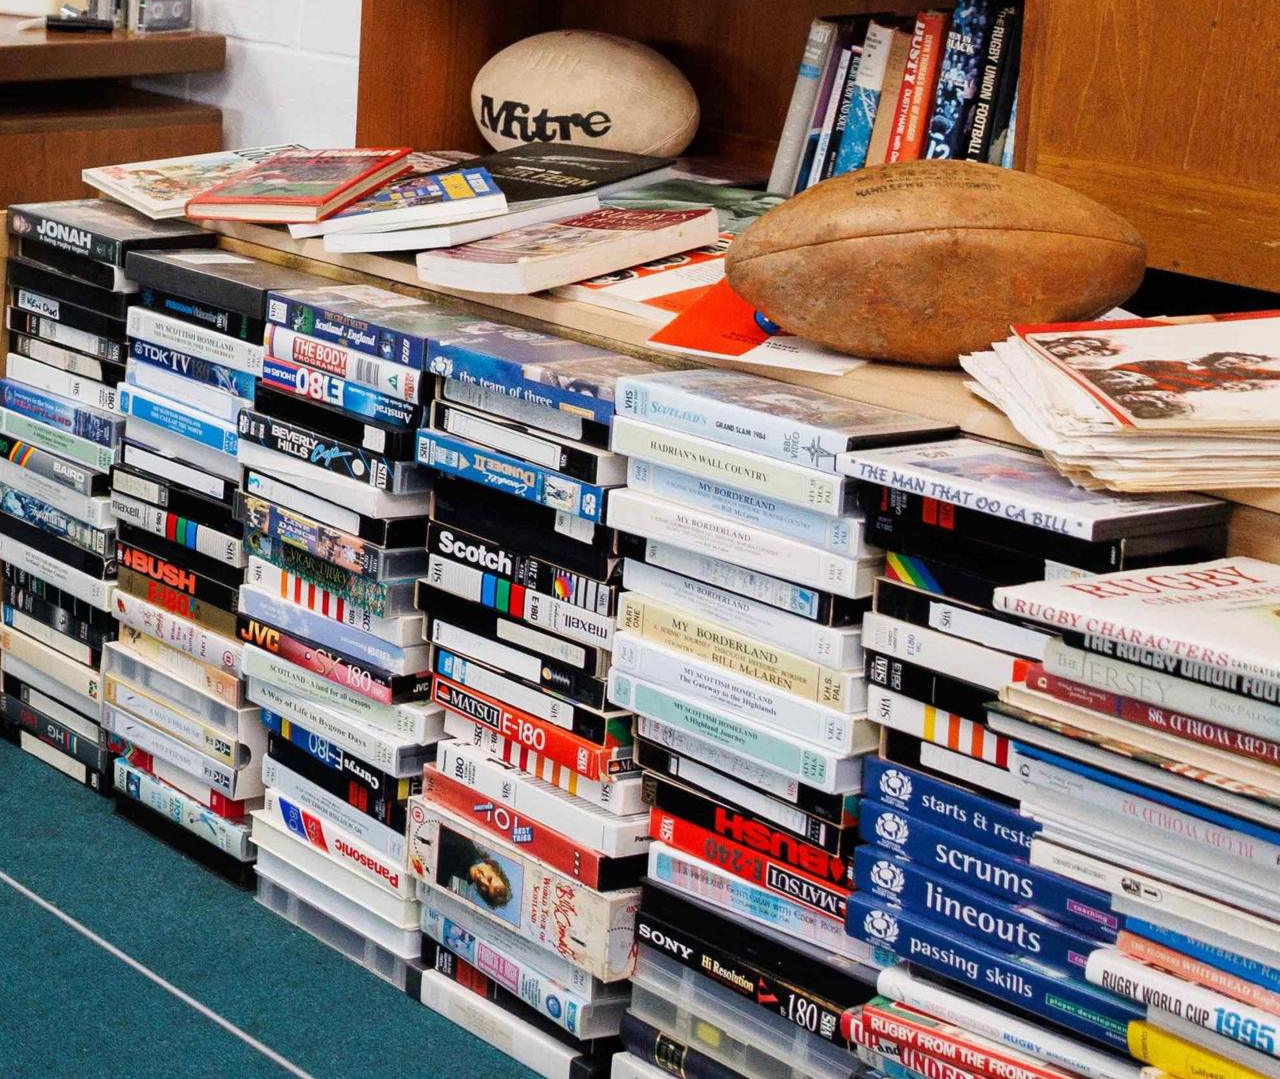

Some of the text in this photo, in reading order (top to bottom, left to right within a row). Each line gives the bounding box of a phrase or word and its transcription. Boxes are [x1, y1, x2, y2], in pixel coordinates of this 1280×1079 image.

[905, 21, 925, 83] DUSTY
[946, 40, 974, 54] BLACK
[967, 11, 1008, 153] THE RUGBY UNION FOOTBALL
[481, 94, 612, 142] Mitre
[836, 77, 859, 132] BODY AND SOUL
[926, 140, 951, 159] 12
[37, 220, 92, 249] JONAH
[294, 338, 348, 367] THE BODY
[294, 354, 347, 377] PROGRAMME
[295, 367, 345, 407] E180
[459, 372, 553, 408] the team of three
[625, 390, 633, 409] VHS
[373, 403, 413, 425] Amstrad
[272, 424, 318, 450] BEVERLY
[716, 421, 766, 440] GRAND SLAM 1984
[783, 433, 791, 454] BBC
[791, 431, 801, 459] VIDEO
[277, 439, 353, 467] HILLS Cop
[650, 440, 769, 483] HADRIAN'S WALL COUNTRY
[53, 462, 85, 482] BAIRD
[112, 500, 140, 519] maxell
[699, 482, 775, 512] MY BORDERLAND
[859, 462, 1069, 534] THE MAN THAT OO CA BILL
[677, 514, 751, 542] MY BORDERLAND
[438, 530, 512, 575] Scotch
[132, 550, 196, 594] BUSH
[1062, 566, 1268, 599] RUGBY
[148, 581, 190, 616] E-180
[531, 596, 539, 620] E-180
[684, 581, 751, 612] MY BORDERLAND
[563, 615, 608, 639] maxell
[625, 605, 633, 628] PART
[633, 609, 641, 629] ONE
[240, 621, 280, 652] JVC
[672, 618, 779, 665] MY BORDERLAND
[1014, 599, 1228, 667] RUGBY CHARACTERS
[315, 648, 373, 692] SX 180
[711, 653, 792, 690] BILL McLAREN
[875, 656, 888, 685] VHS
[413, 682, 429, 692] JVC
[832, 683, 841, 701] PAL
[451, 689, 499, 727] MATSUI
[880, 698, 891, 718] VHS
[502, 714, 546, 751] E-180
[344, 758, 380, 790] Currys
[455, 757, 465, 779] 180
[577, 747, 588, 772] VHS
[660, 816, 674, 841] VHS
[716, 807, 830, 876] BUSH
[335, 838, 399, 889] Panasonic
[936, 843, 1034, 899] scrums
[770, 869, 838, 913] MATSUI
[925, 882, 1042, 953] lineouts
[639, 923, 693, 959] SONY
[702, 954, 754, 993] Hi Resolution
[910, 936, 1033, 998] passing skills
[820, 1011, 836, 1040] VHS
[1101, 969, 1276, 1053] RUGBY WORLD CUP 1995
[871, 1018, 1037, 1079] RUGBY FROM THE FRONT
